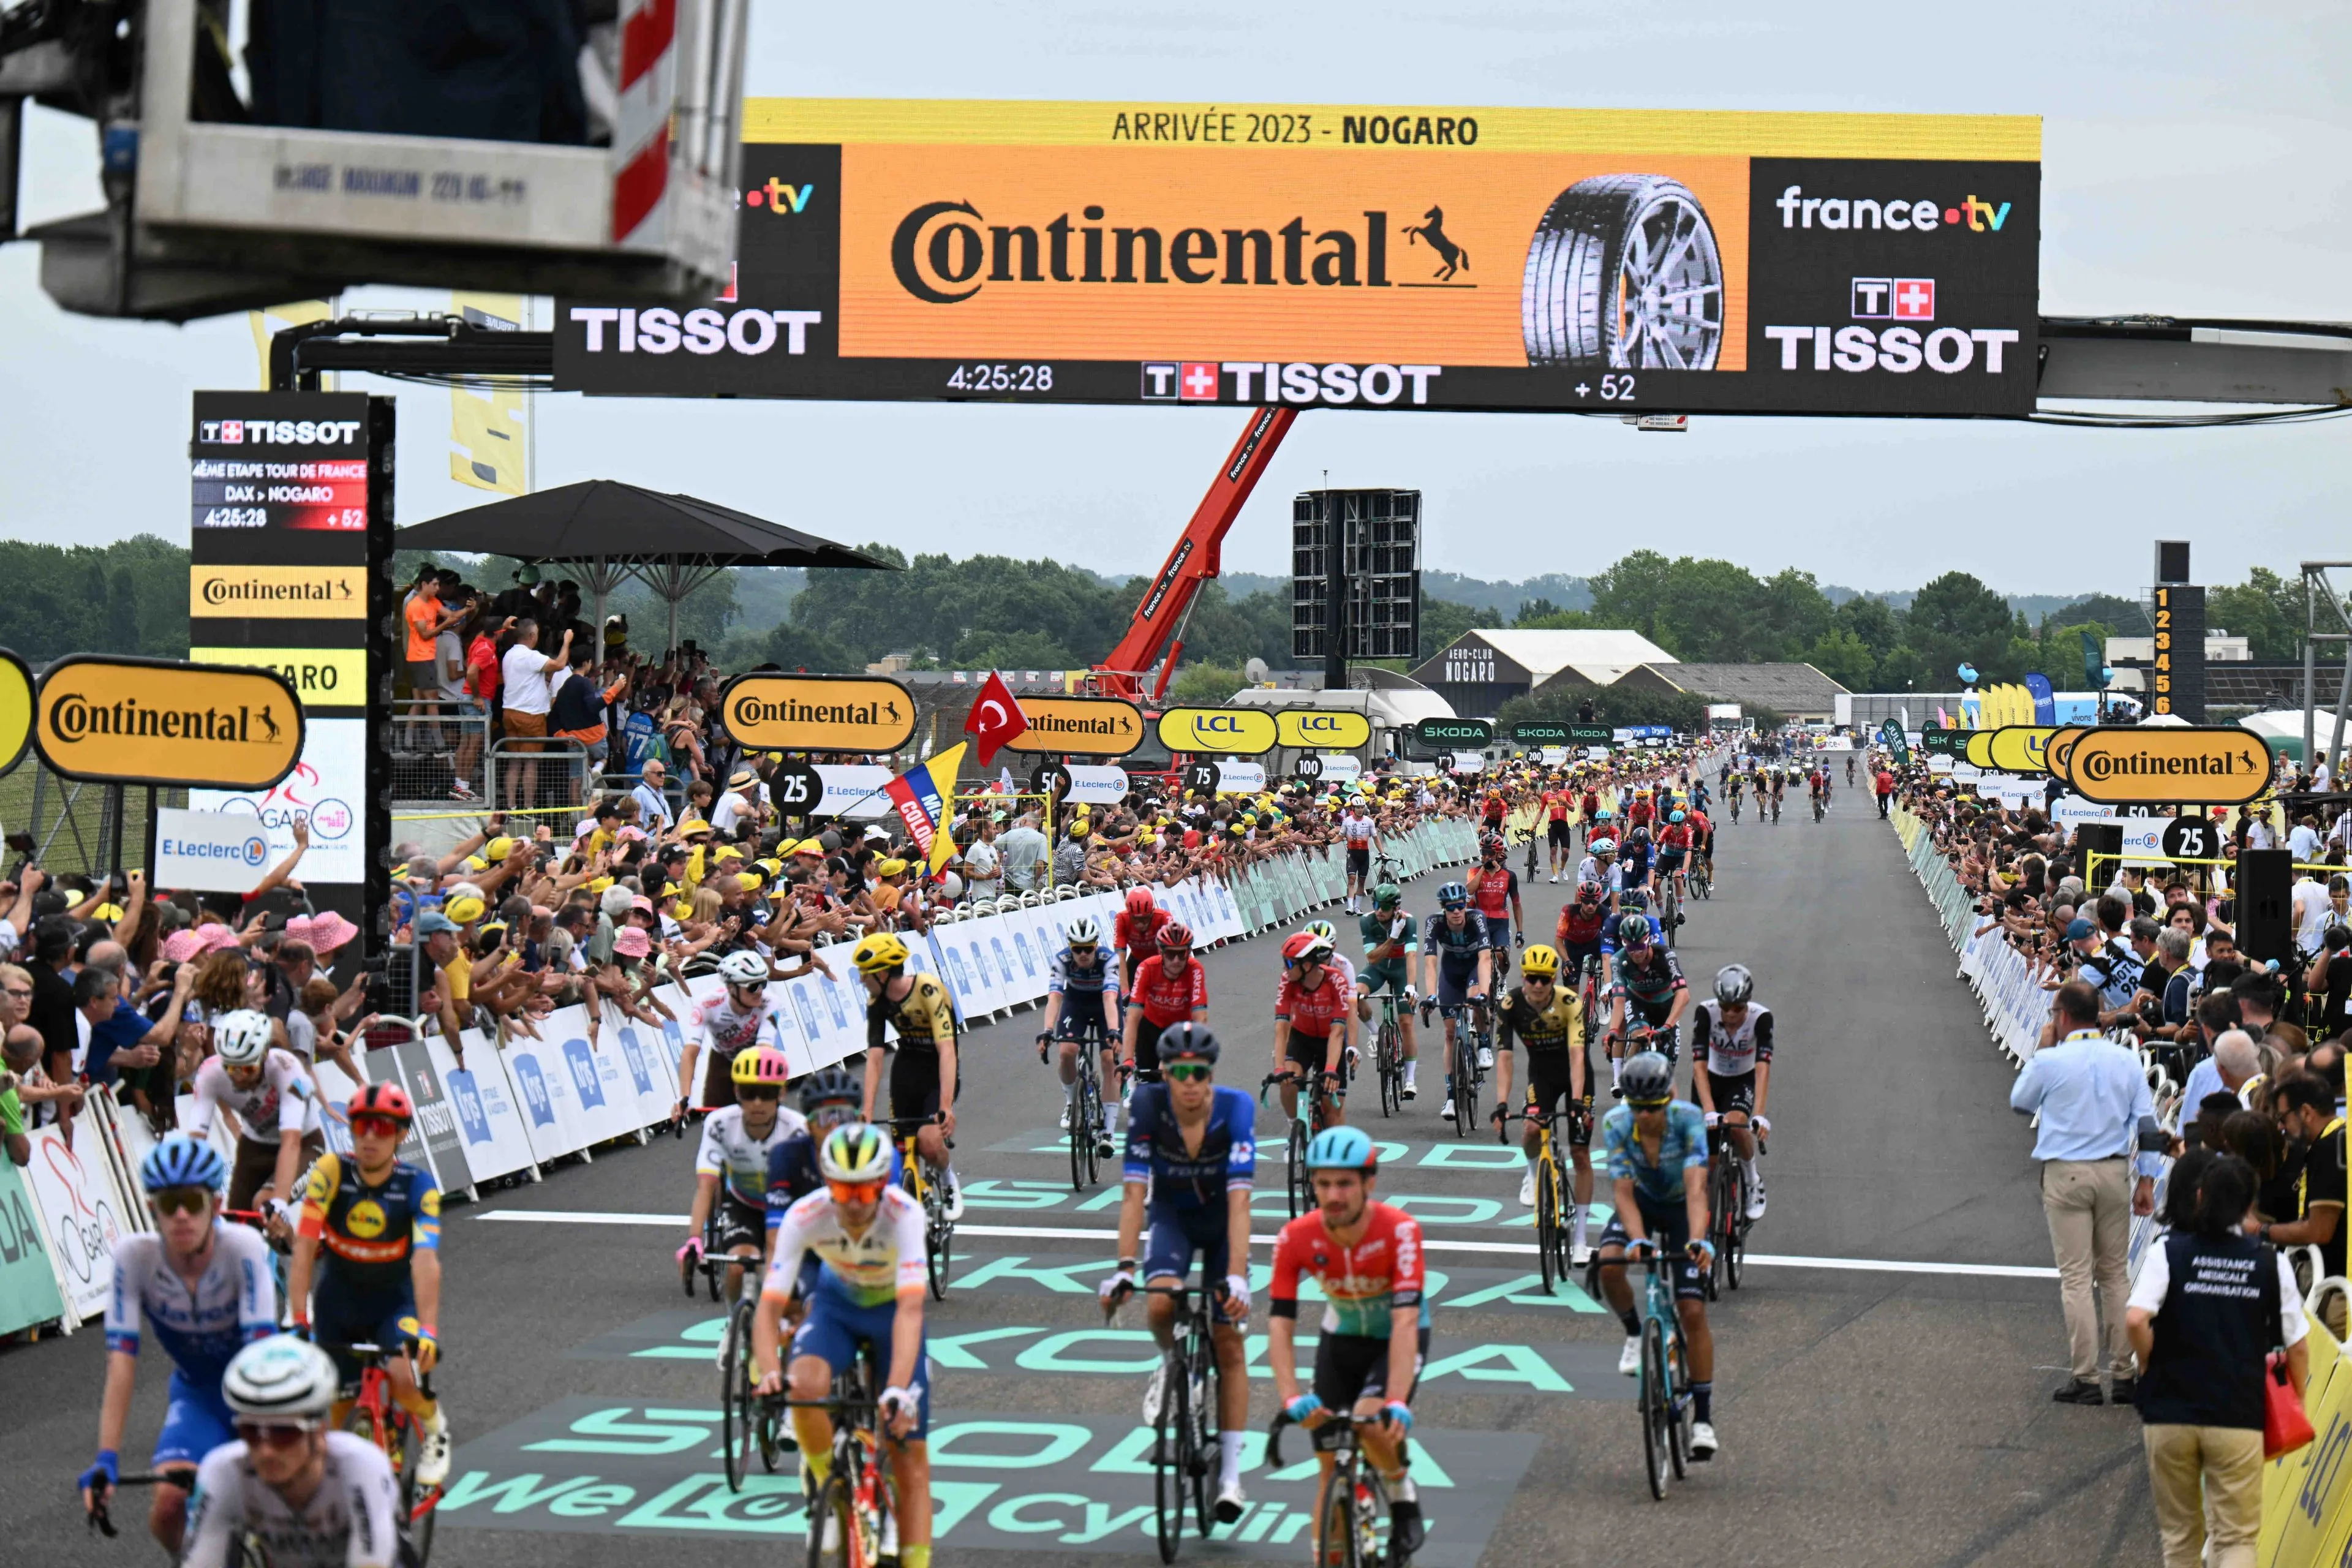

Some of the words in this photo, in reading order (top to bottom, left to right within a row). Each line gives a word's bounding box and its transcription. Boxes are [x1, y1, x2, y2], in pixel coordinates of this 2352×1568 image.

[1112, 107, 1236, 142] ARRIVÉE
[1246, 114, 1311, 143] 2023
[1343, 115, 1478, 146] NOGARO
[891, 198, 1392, 304] Continental
[570, 307, 821, 355] TISSOT
[1765, 326, 2019, 374] TISSOT
[947, 365, 1053, 391] 4:25:28
[1221, 362, 1441, 404] TISSOT
[1600, 375, 1635, 401] 52
[245, 421, 360, 445] TISSOT
[227, 464, 264, 478] ETAPE
[265, 464, 298, 478] TOUR
[300, 464, 316, 478] DE
[318, 464, 367, 478] FRANCE
[225, 486, 255, 502] DAX
[268, 486, 334, 502] NOGARO
[203, 508, 267, 528] 4:25:28
[342, 510, 363, 528] 52
[203, 578, 331, 605] Continental
[2156, 589, 2170, 606] 1
[2156, 611, 2170, 628] 2
[2156, 632, 2170, 650] 3
[1449, 648, 1492, 660] AERO-CLUB
[2156, 654, 2170, 671] 4
[270, 665, 337, 691] ARO
[1446, 662, 1494, 682] NOGARO
[2156, 676, 2170, 693] 5
[734, 696, 878, 727] Continental
[2156, 697, 2170, 714] 6
[50, 693, 248, 743] Continental
[1027, 714, 1115, 734] ntinental
[1197, 715, 1245, 733] LCL
[1302, 717, 1342, 731] LCL
[627, 731, 649, 759] 77
[1887, 725, 1905, 753] JULES
[1528, 752, 1542, 761] 200
[2083, 749, 2233, 782] Continental
[1196, 767, 1211, 785] 75
[1299, 760, 1318, 775] 100
[783, 775, 808, 802] 25
[1041, 774, 1059, 793] 50
[1075, 779, 1112, 788] E.Leclerc
[2062, 808, 2100, 816] E.Leclerc
[900, 801, 933, 854] COLOM
[162, 839, 239, 859] E.Leclerc
[2179, 827, 2204, 856] 25
[1329, 973, 1349, 1011] ARKEA
[2121, 976, 2139, 998] 98
[1148, 993, 1189, 1006] ARKEA
[1714, 1036, 1749, 1049] UAE
[570, 1054, 595, 1095] Krys
[520, 1069, 546, 1113] Krys
[453, 1085, 482, 1130] Krys
[418, 1100, 455, 1137] TISSOT
[2192, 1255, 2256, 1272] ASSISTANCE
[2197, 1269, 2249, 1284] MEDICALE
[2184, 1281, 2260, 1299] ORGANISATION
